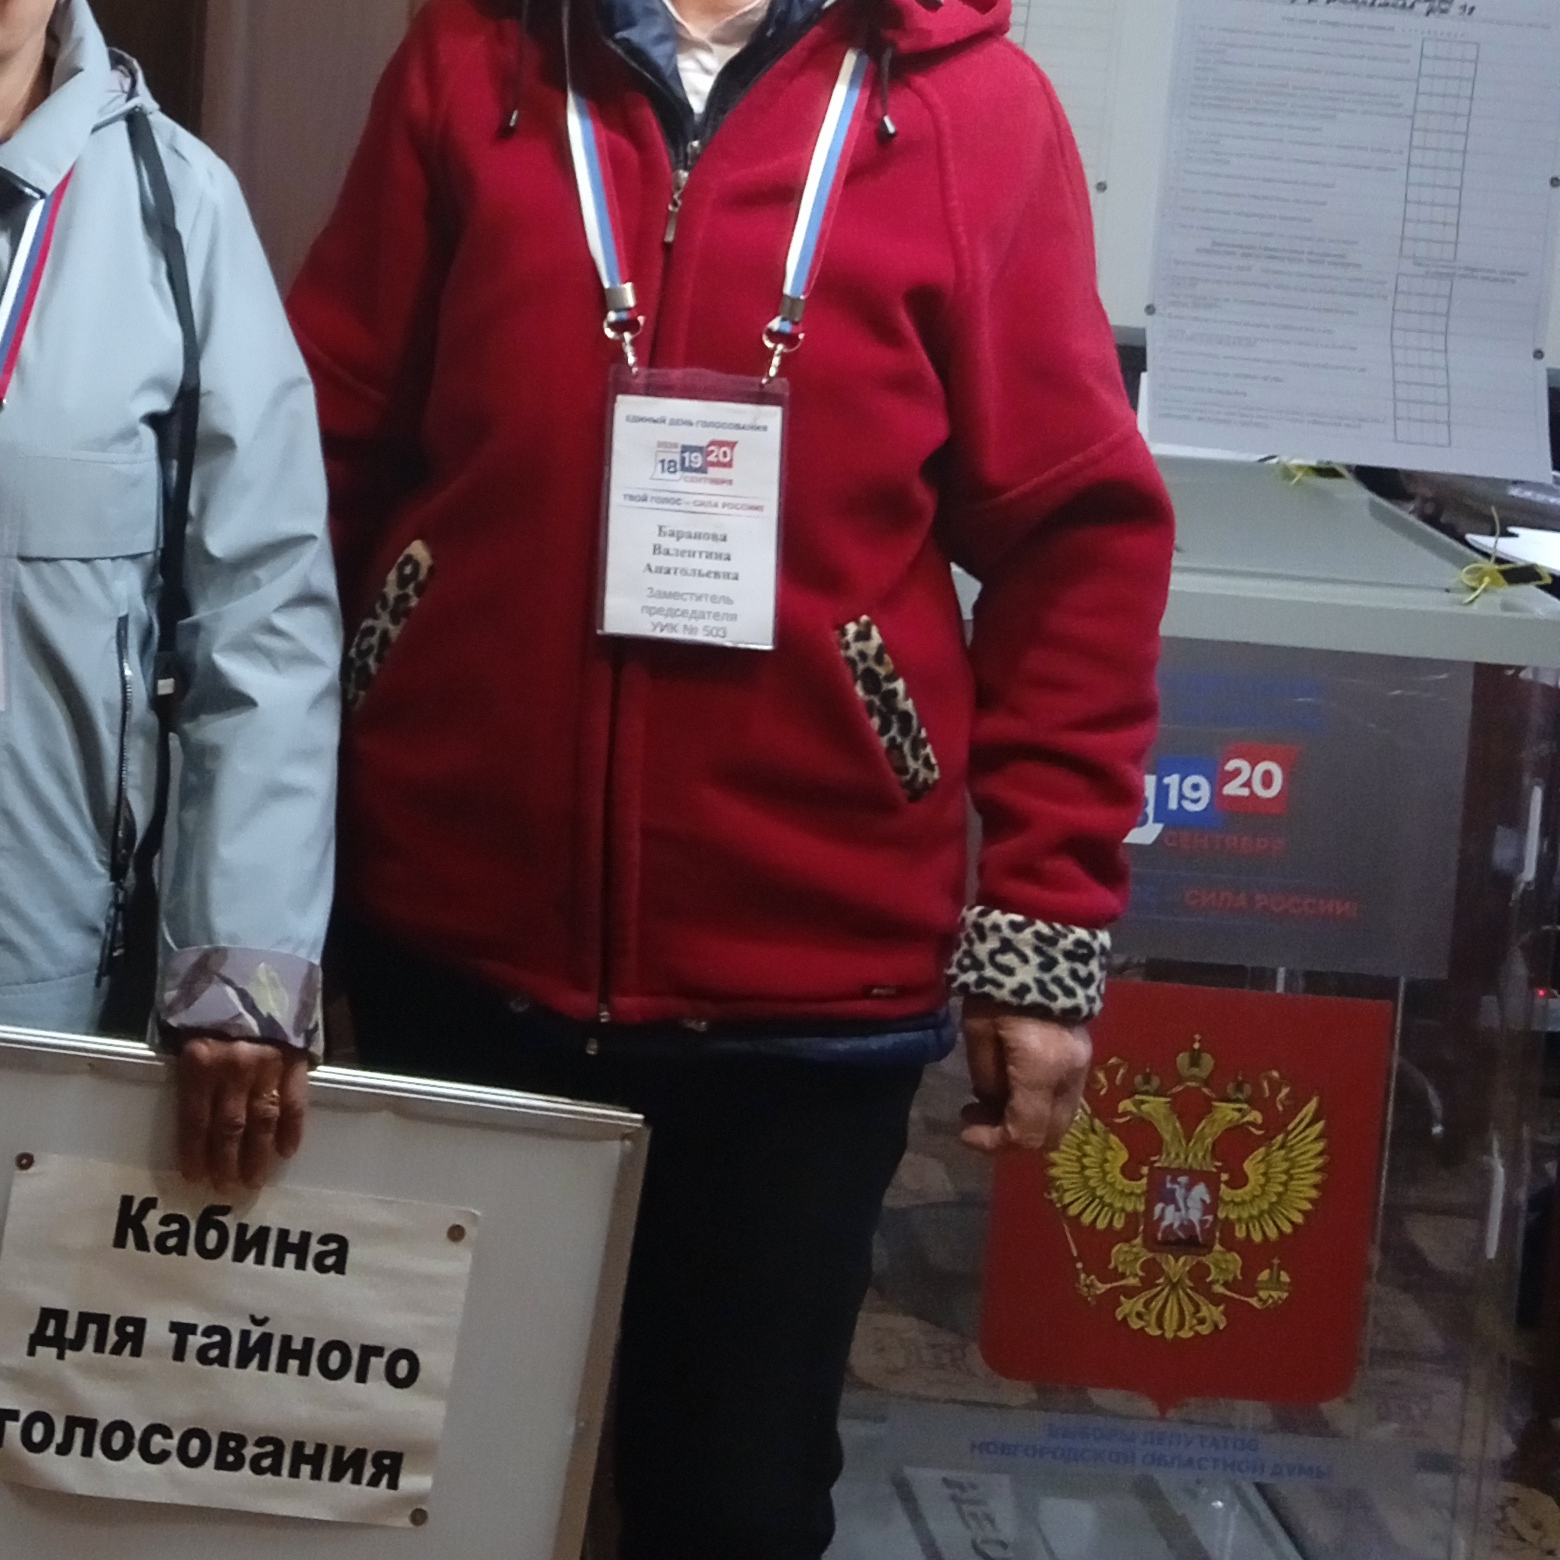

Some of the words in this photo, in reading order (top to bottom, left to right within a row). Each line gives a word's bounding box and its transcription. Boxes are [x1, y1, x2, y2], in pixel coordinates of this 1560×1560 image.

[681, 451, 703, 468] 19
[706, 446, 731, 463] 20
[658, 458, 679, 474] 18
[651, 543, 732, 562] Валентина
[642, 562, 740, 582] Анатольевна
[646, 586, 735, 606] Заместитель
[640, 604, 738, 624] председателя
[650, 621, 678, 635] УИК
[682, 622, 698, 637] №
[702, 623, 728, 640] 503
[1221, 757, 1284, 800] 20
[1161, 772, 1212, 813] 19
[1183, 888, 1249, 909] СИЛА
[112, 1193, 350, 1276] Кабина
[26, 1305, 148, 1360] для
[168, 1314, 422, 1390] тайного
[1139, 1429, 1260, 1454] ДЕПУТАТОВ
[968, 1438, 1137, 1468] НОВГОРОДСКОЙ
[1139, 1451, 1267, 1477] ОБЛАСТНОЙ
